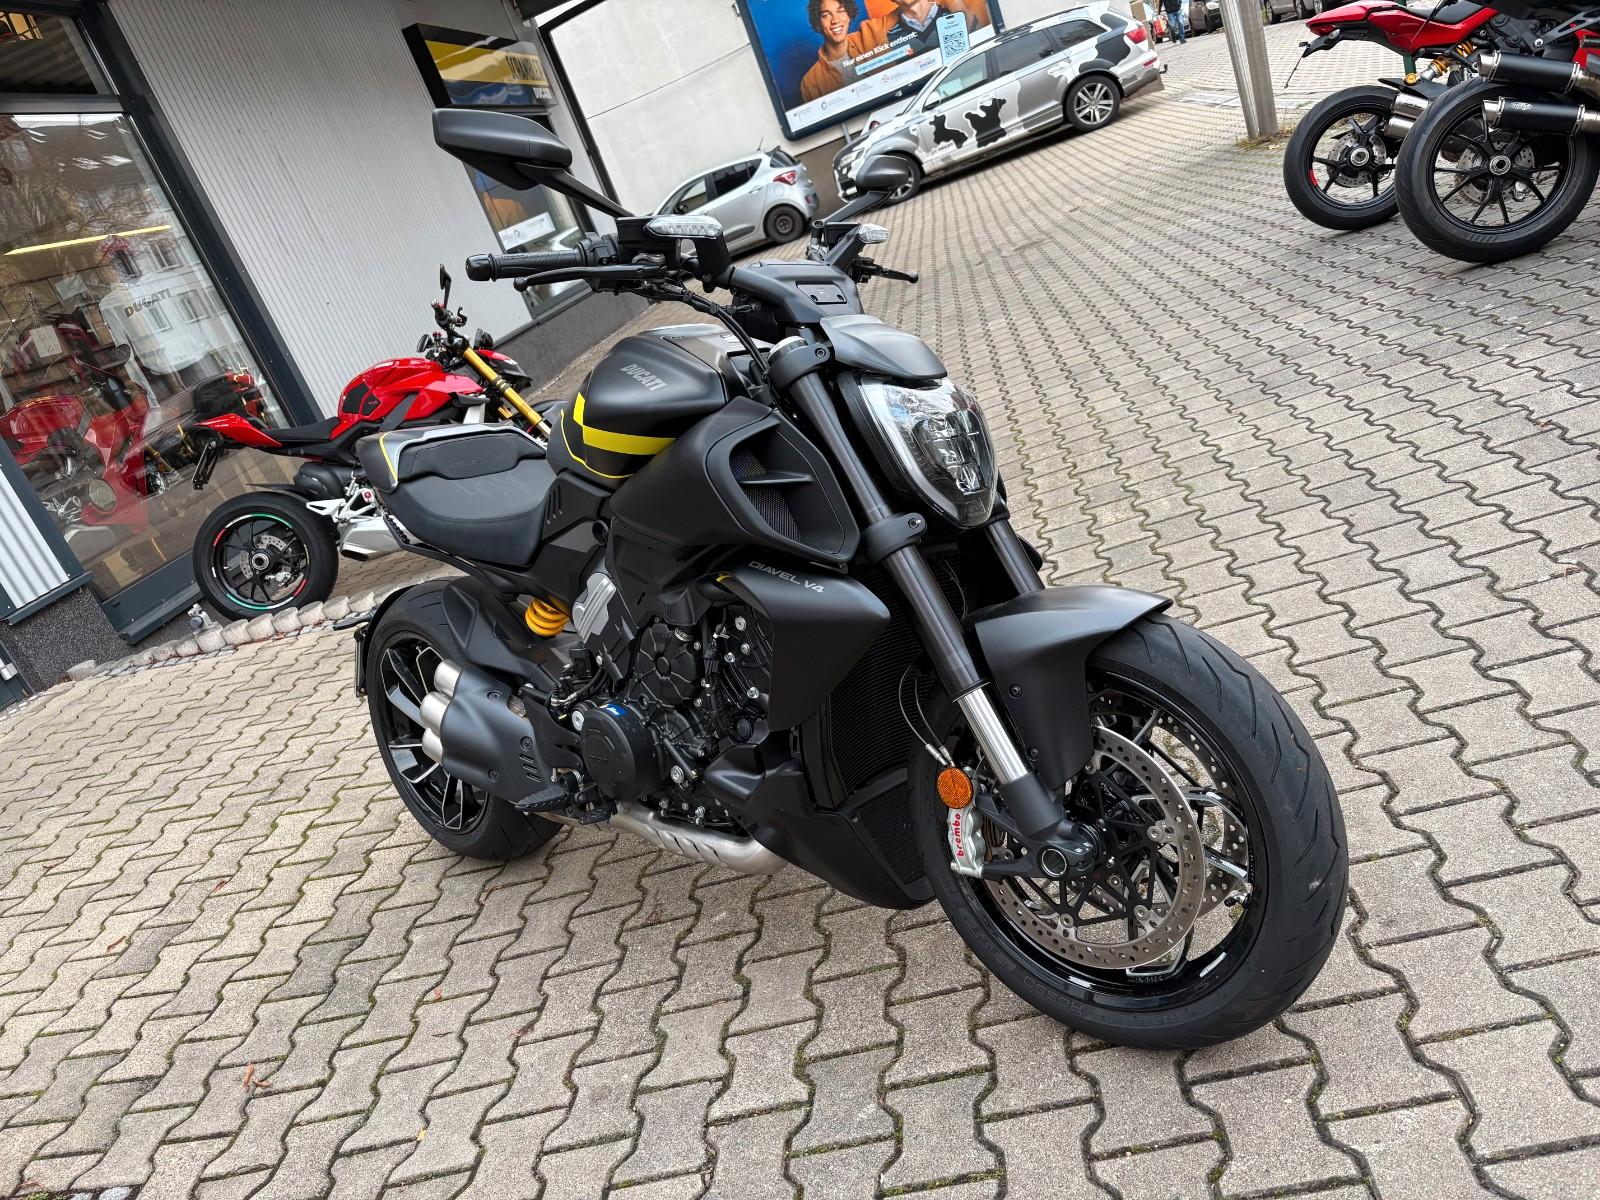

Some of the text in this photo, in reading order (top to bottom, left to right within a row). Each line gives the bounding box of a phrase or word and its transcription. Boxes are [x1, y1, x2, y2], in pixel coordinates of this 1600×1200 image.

[842, 58, 855, 67] Nur
[855, 50, 874, 61] einen
[873, 43, 890, 54] Klick
[124, 288, 171, 318] DUCATI
[619, 363, 668, 392] DUCATI
[748, 560, 825, 593] DIAVEL V4
[952, 813, 965, 857] brembo
